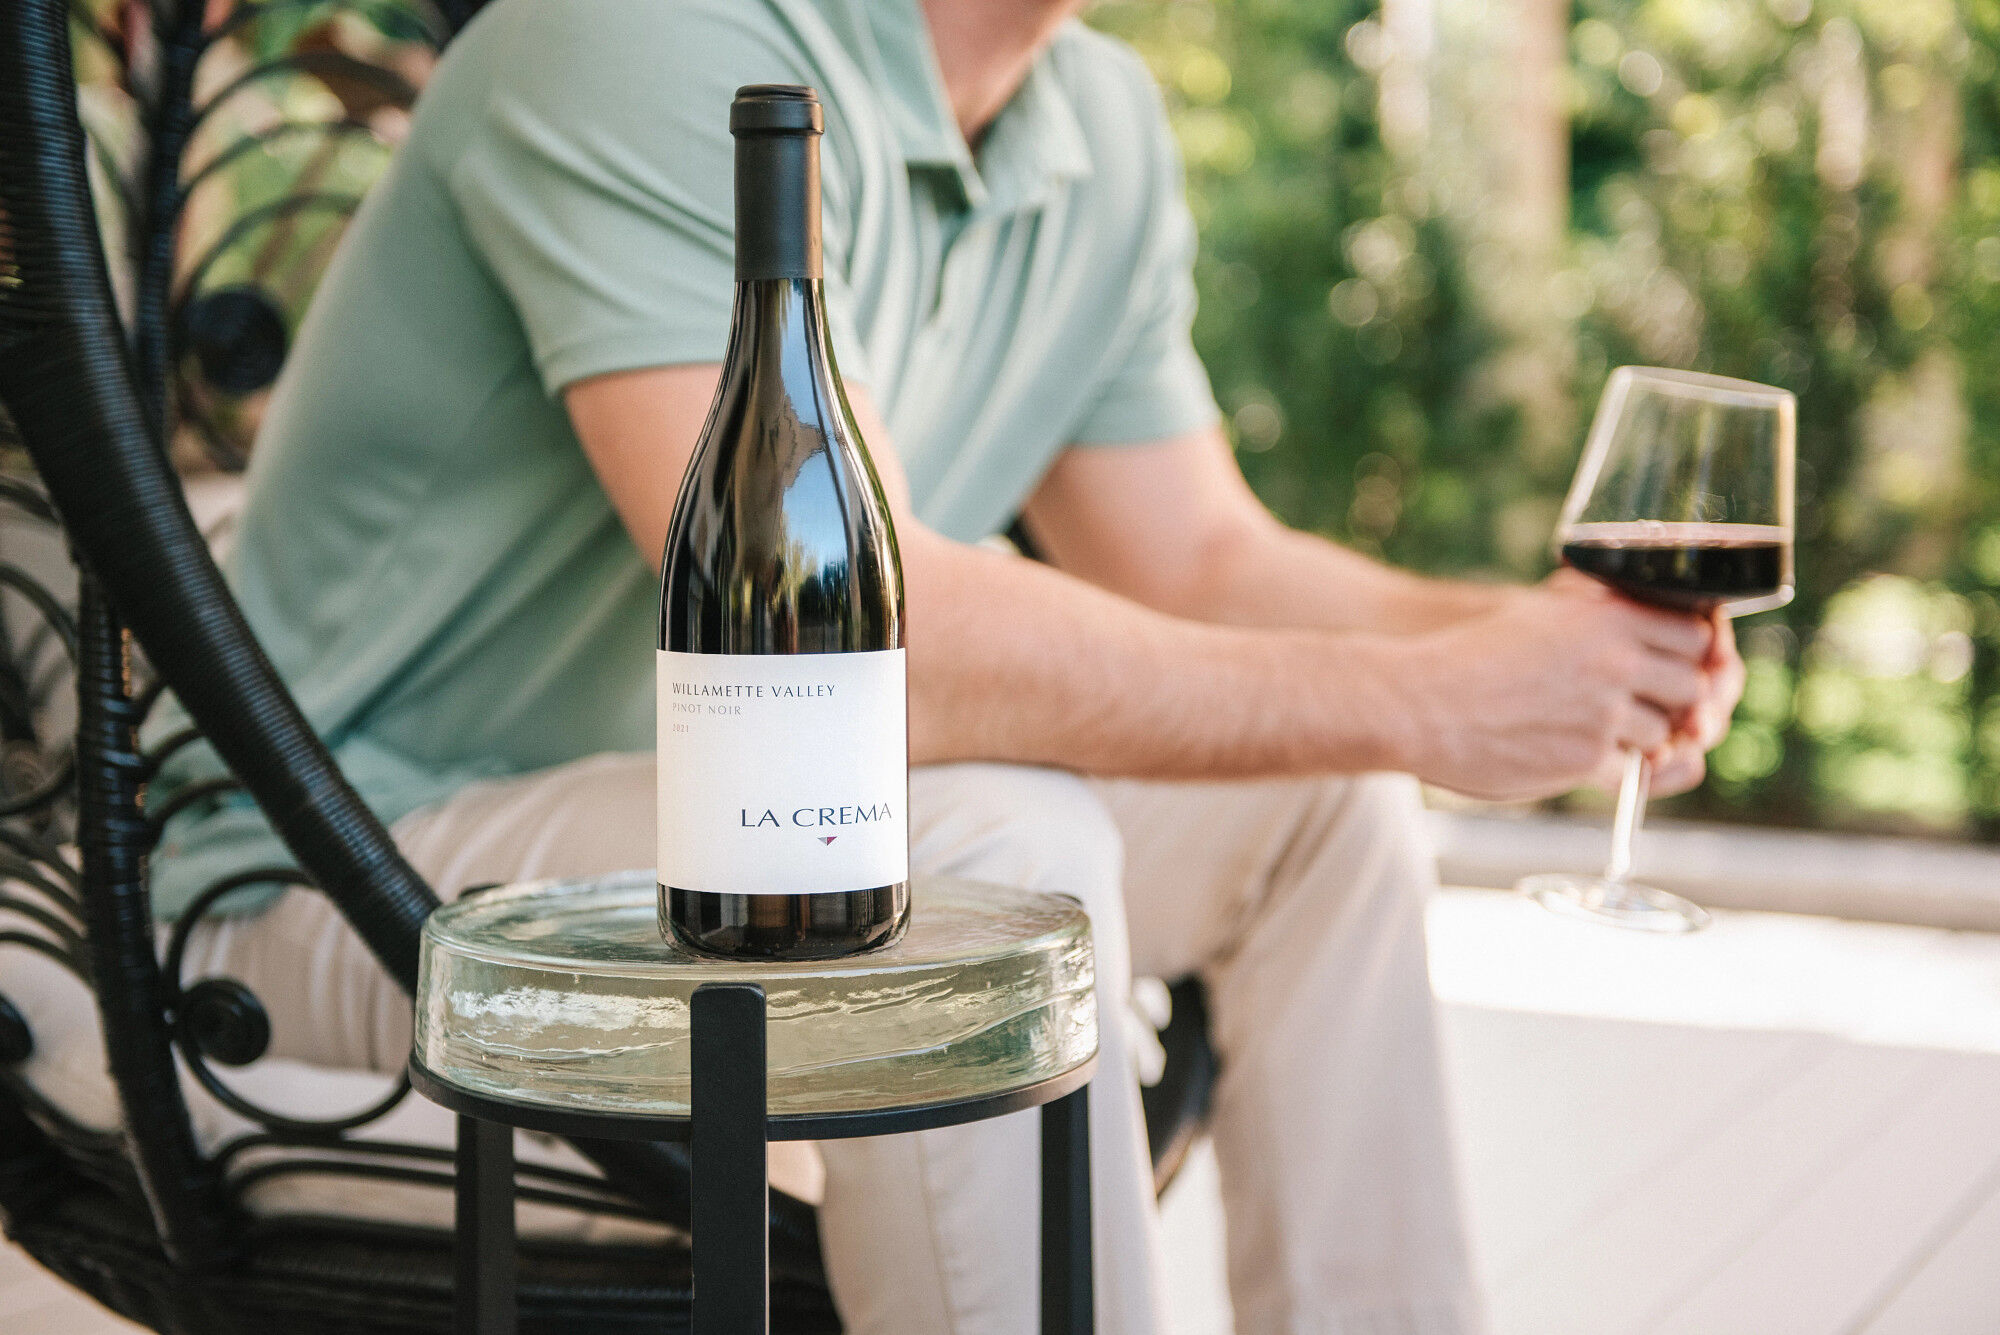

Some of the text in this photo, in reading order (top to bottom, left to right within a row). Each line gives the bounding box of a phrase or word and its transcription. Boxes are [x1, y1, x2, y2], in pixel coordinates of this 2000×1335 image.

[672, 682, 836, 698] WILLAMETTE VALLEY
[672, 702, 742, 716] PINOT NOIR
[672, 723, 690, 733] 2021
[741, 802, 892, 828] LA CREMA
